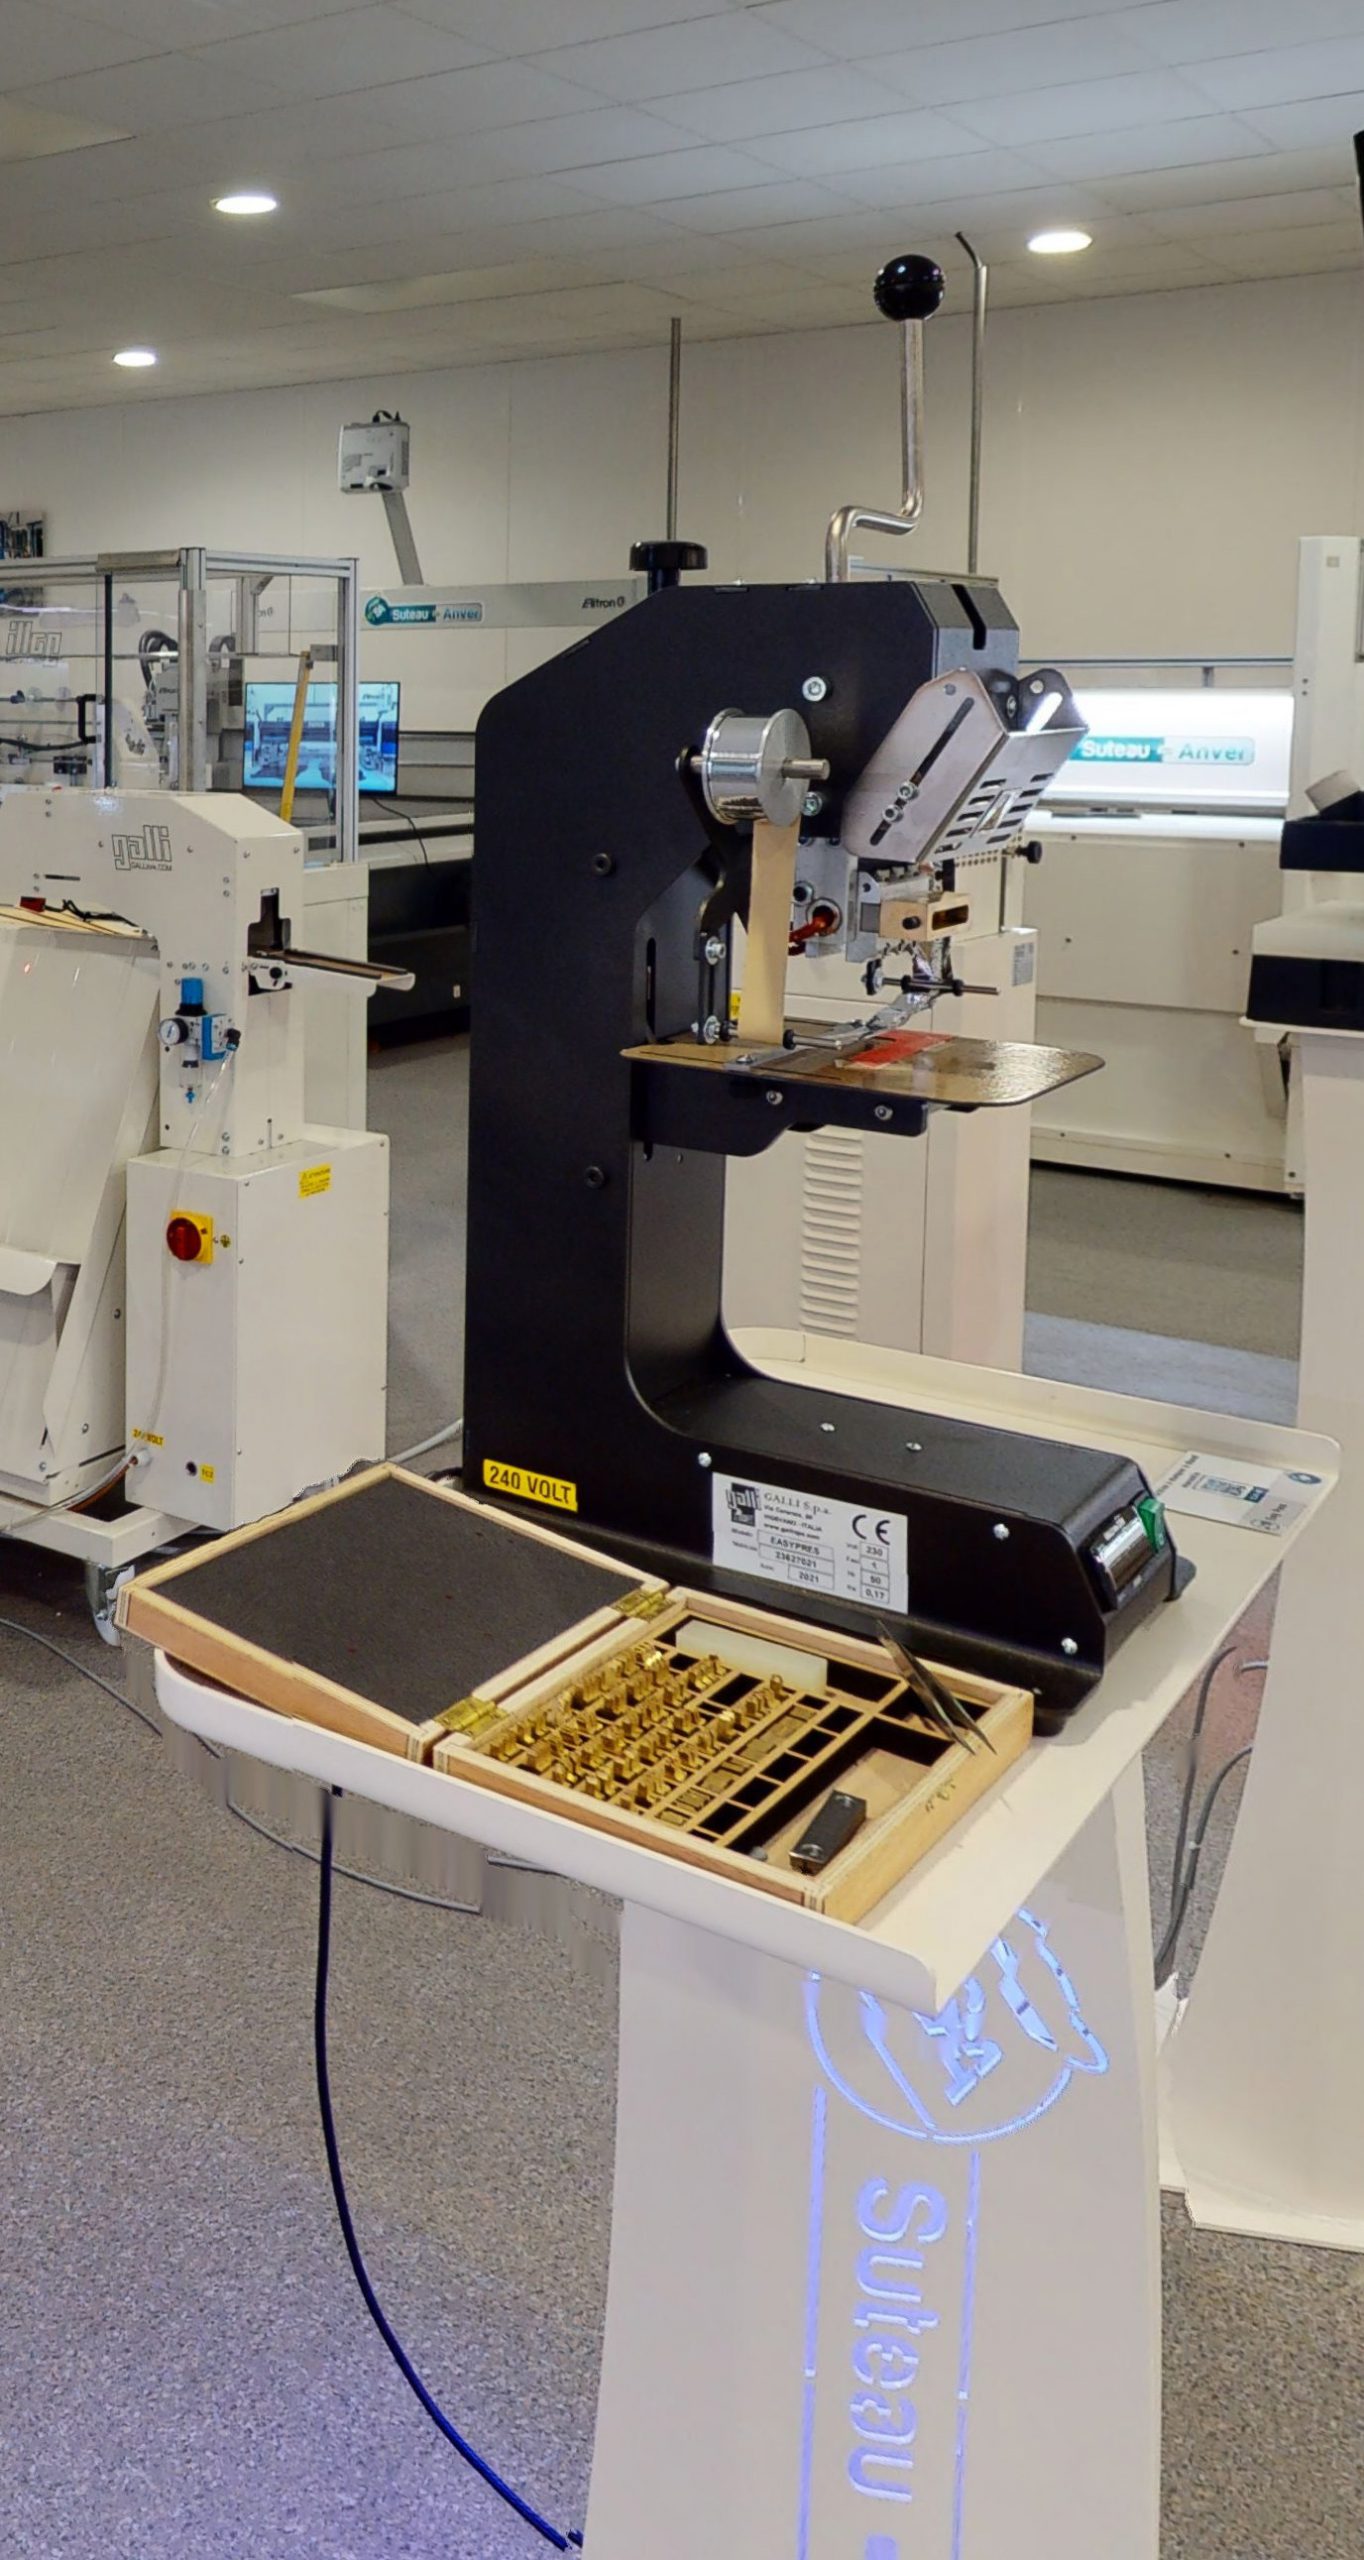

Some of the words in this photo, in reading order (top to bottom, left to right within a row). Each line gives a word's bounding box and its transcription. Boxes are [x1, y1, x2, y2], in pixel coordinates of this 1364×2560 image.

[392, 608, 430, 621] Suteau
[443, 608, 480, 621] Anver
[1081, 740, 1151, 759] Suteau
[489, 1465, 521, 1490] 240
[526, 1475, 572, 1504] VOLT
[764, 1492, 801, 1508] GALLI
[770, 1536, 820, 1556] EASYPRES
[865, 1546, 883, 1557] 230
[798, 1570, 820, 1584] 2021
[865, 1589, 886, 1600] 0,17
[847, 2177, 949, 2502] Suteau
